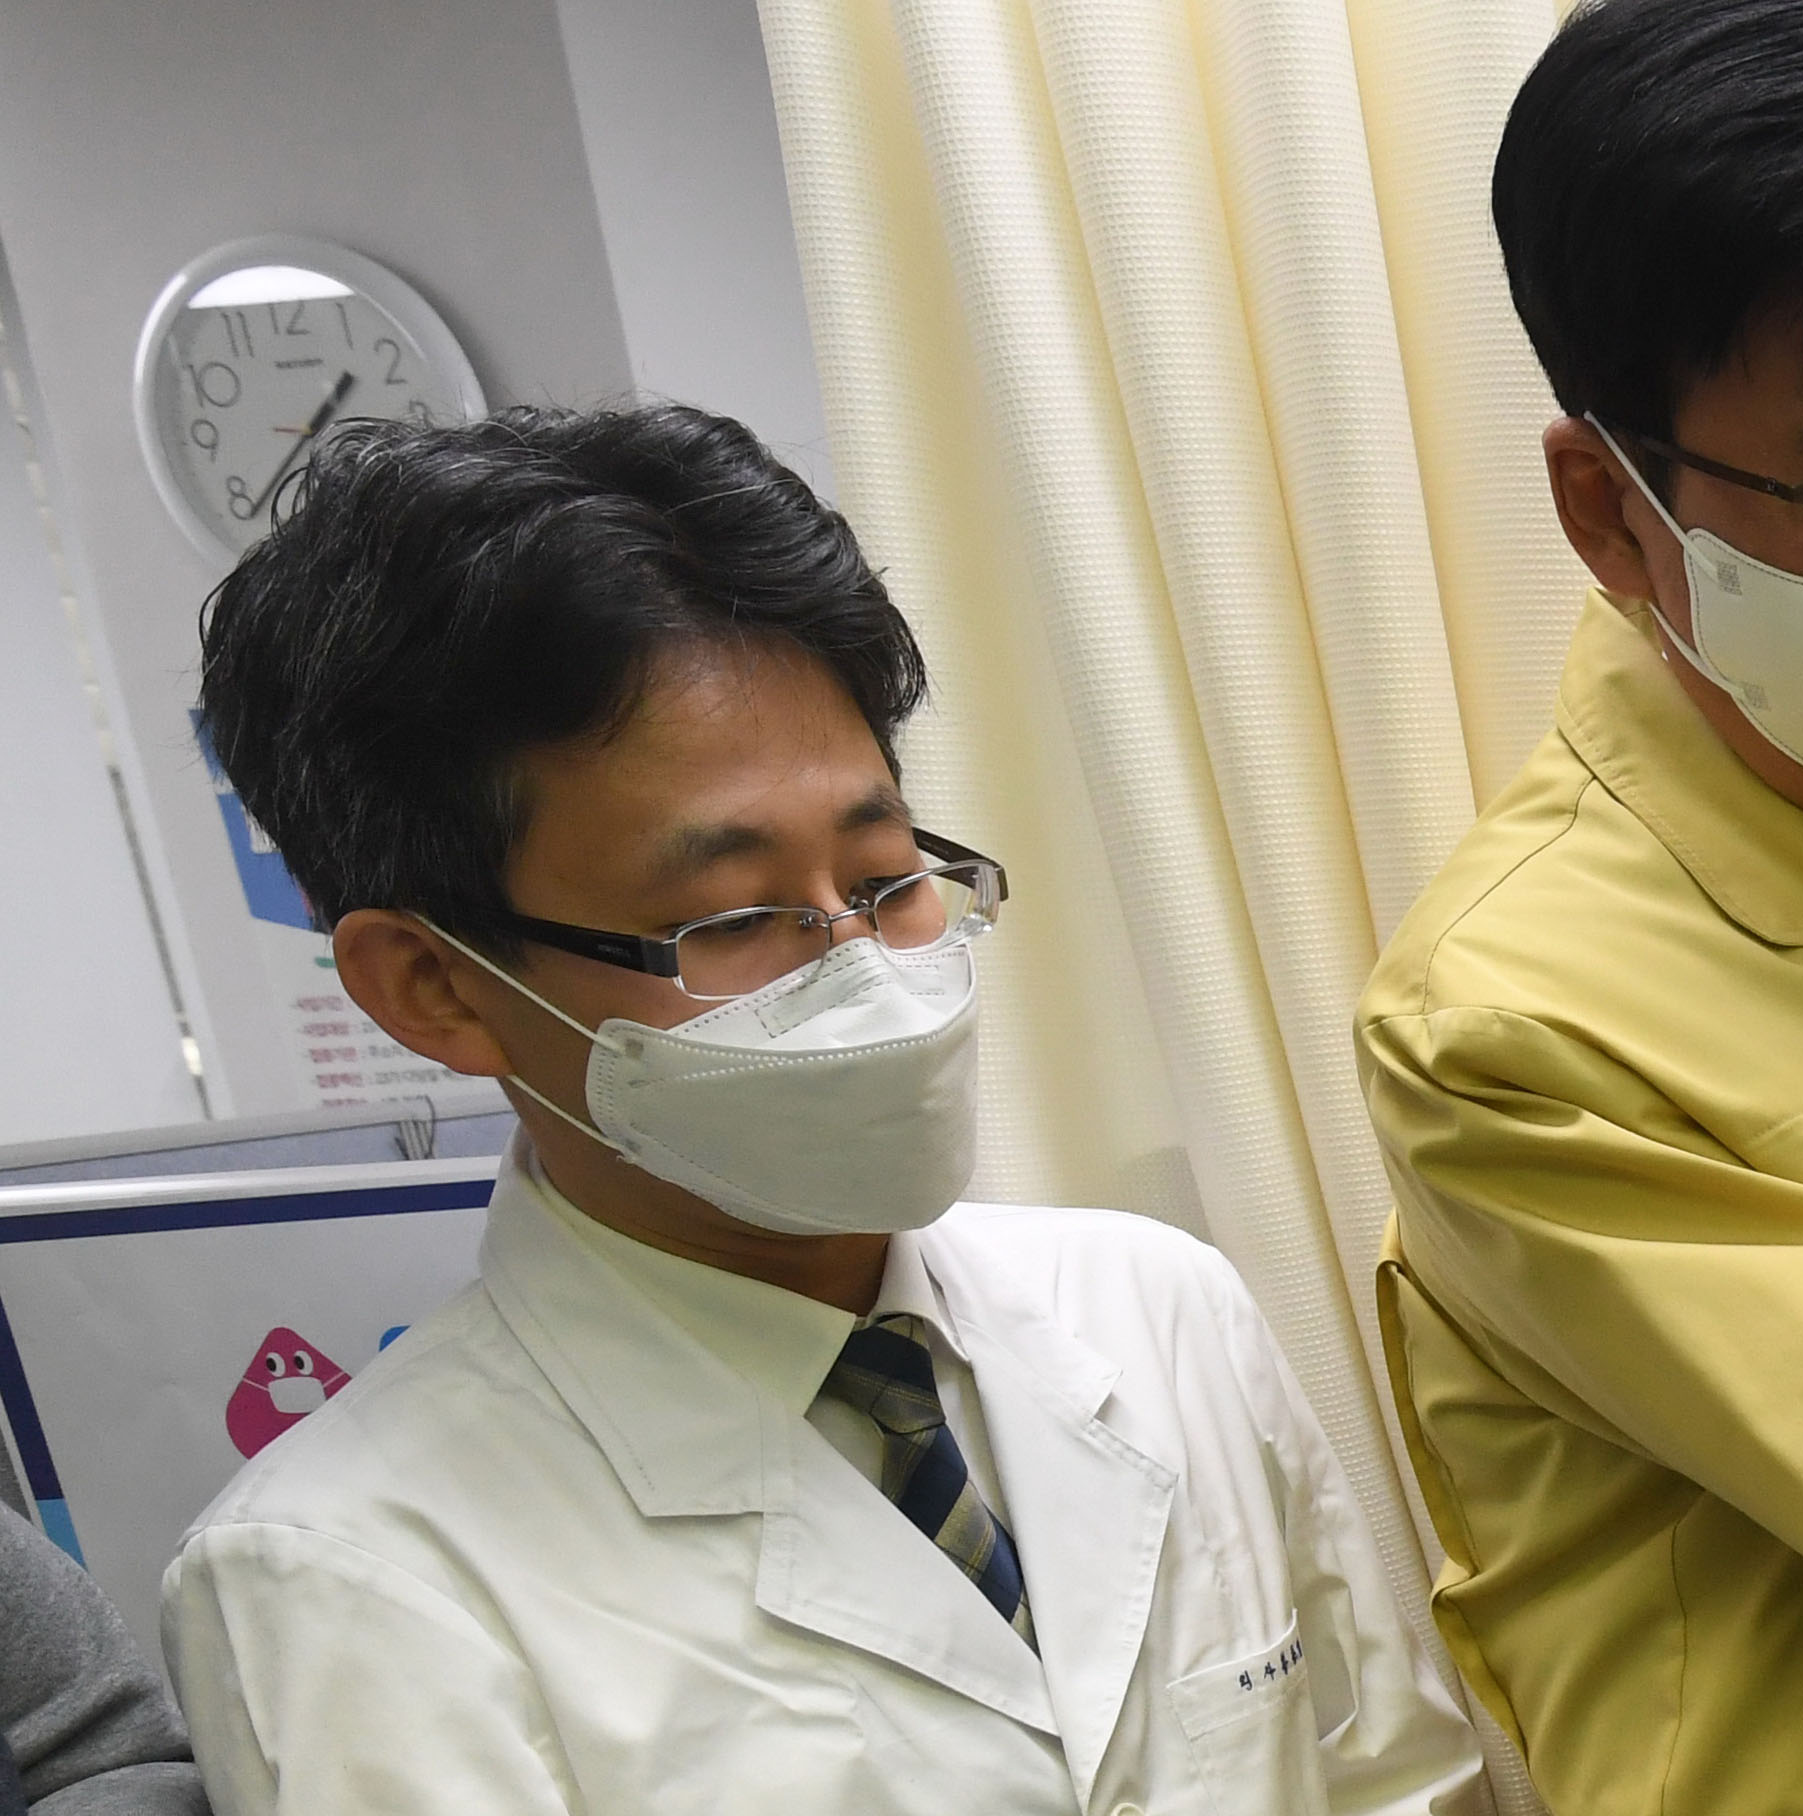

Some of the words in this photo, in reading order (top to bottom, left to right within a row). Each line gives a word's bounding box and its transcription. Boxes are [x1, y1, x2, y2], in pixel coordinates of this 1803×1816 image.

[220, 311, 255, 359] 11
[185, 361, 242, 409] 10
[373, 338, 408, 385] 2
[190, 418, 219, 463] 9
[226, 475, 257, 520] 8
